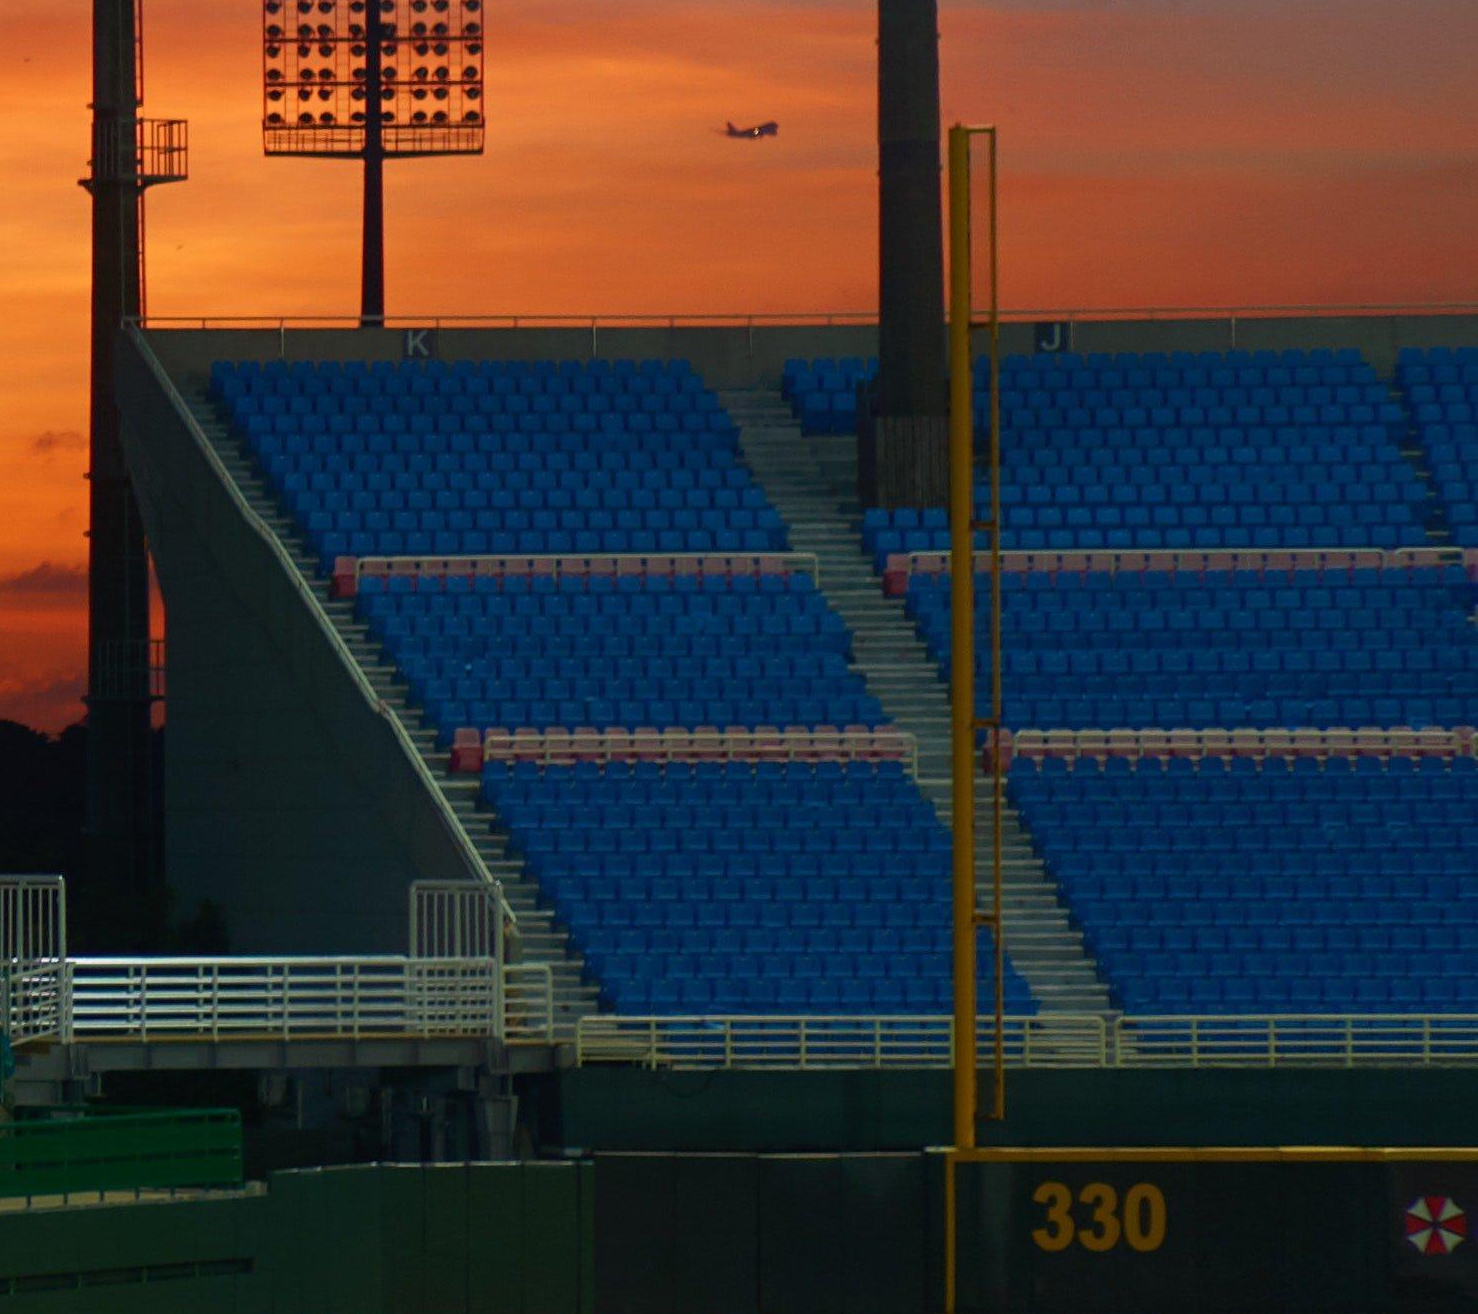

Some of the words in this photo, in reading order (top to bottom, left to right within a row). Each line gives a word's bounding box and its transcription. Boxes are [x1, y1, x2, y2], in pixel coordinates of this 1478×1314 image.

[406, 330, 429, 357] K
[1042, 323, 1062, 351] J
[1030, 1180, 1168, 1253] 330
